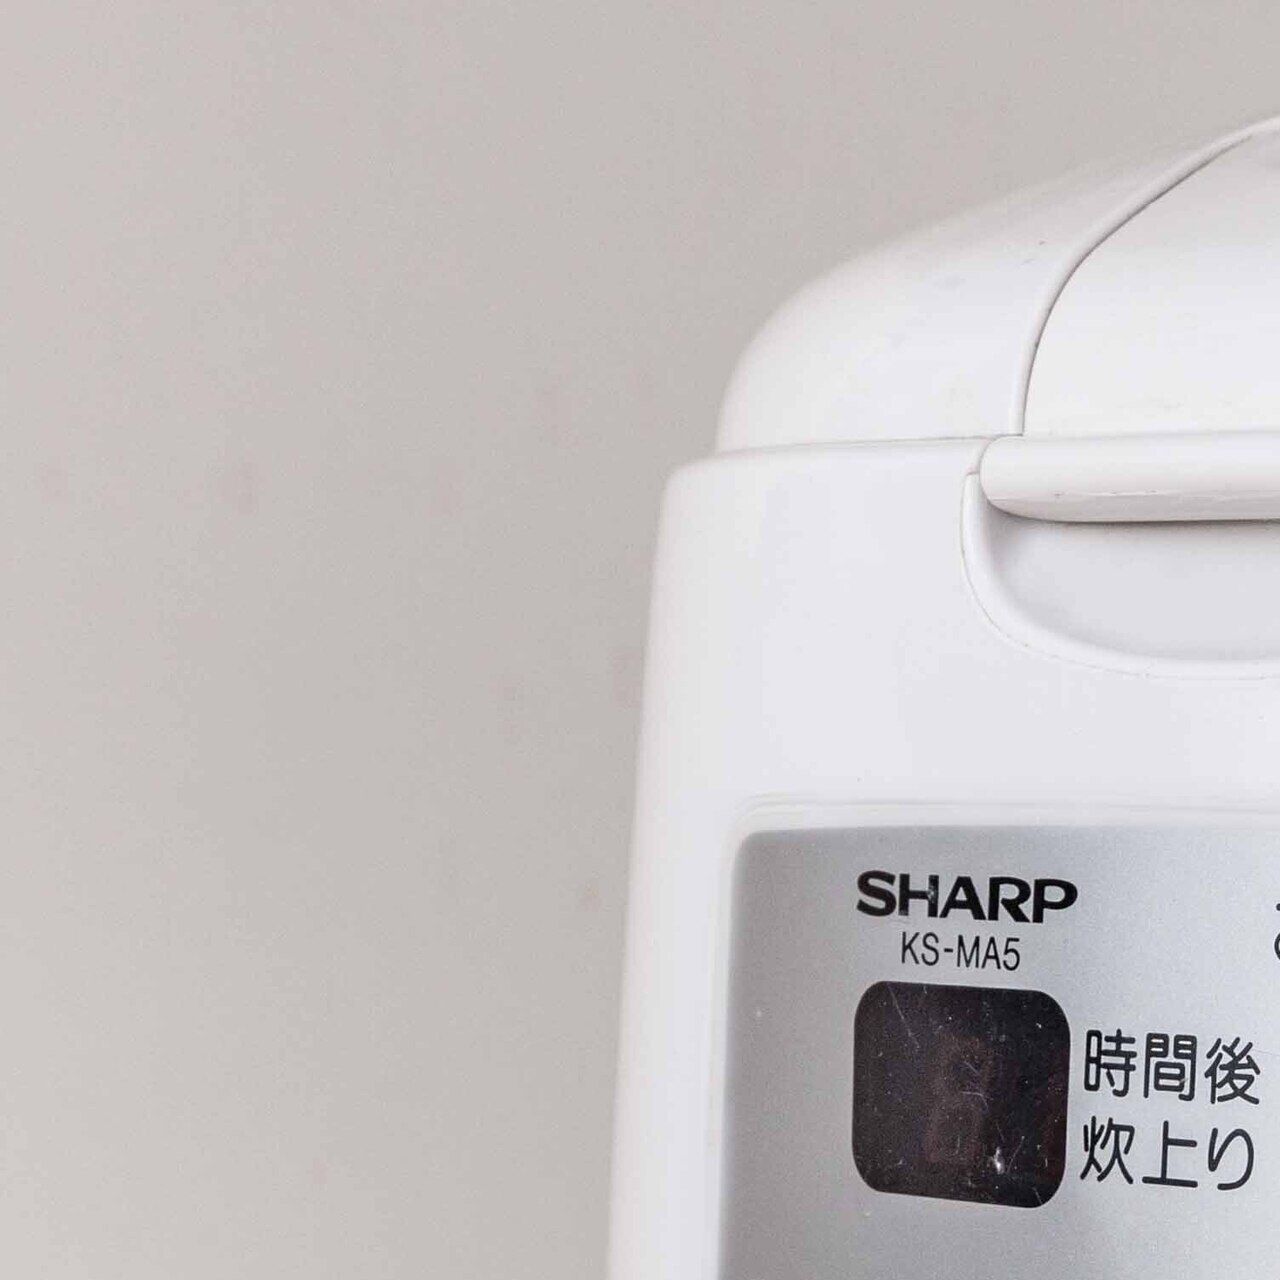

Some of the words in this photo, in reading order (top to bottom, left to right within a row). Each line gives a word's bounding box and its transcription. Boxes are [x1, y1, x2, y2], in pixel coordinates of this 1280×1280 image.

[855, 870, 1078, 924] SHARP
[900, 931, 1021, 971] KS-MA5
[1083, 1028, 1261, 1105] 時間後
[1080, 1116, 1255, 1191] 炊上り
